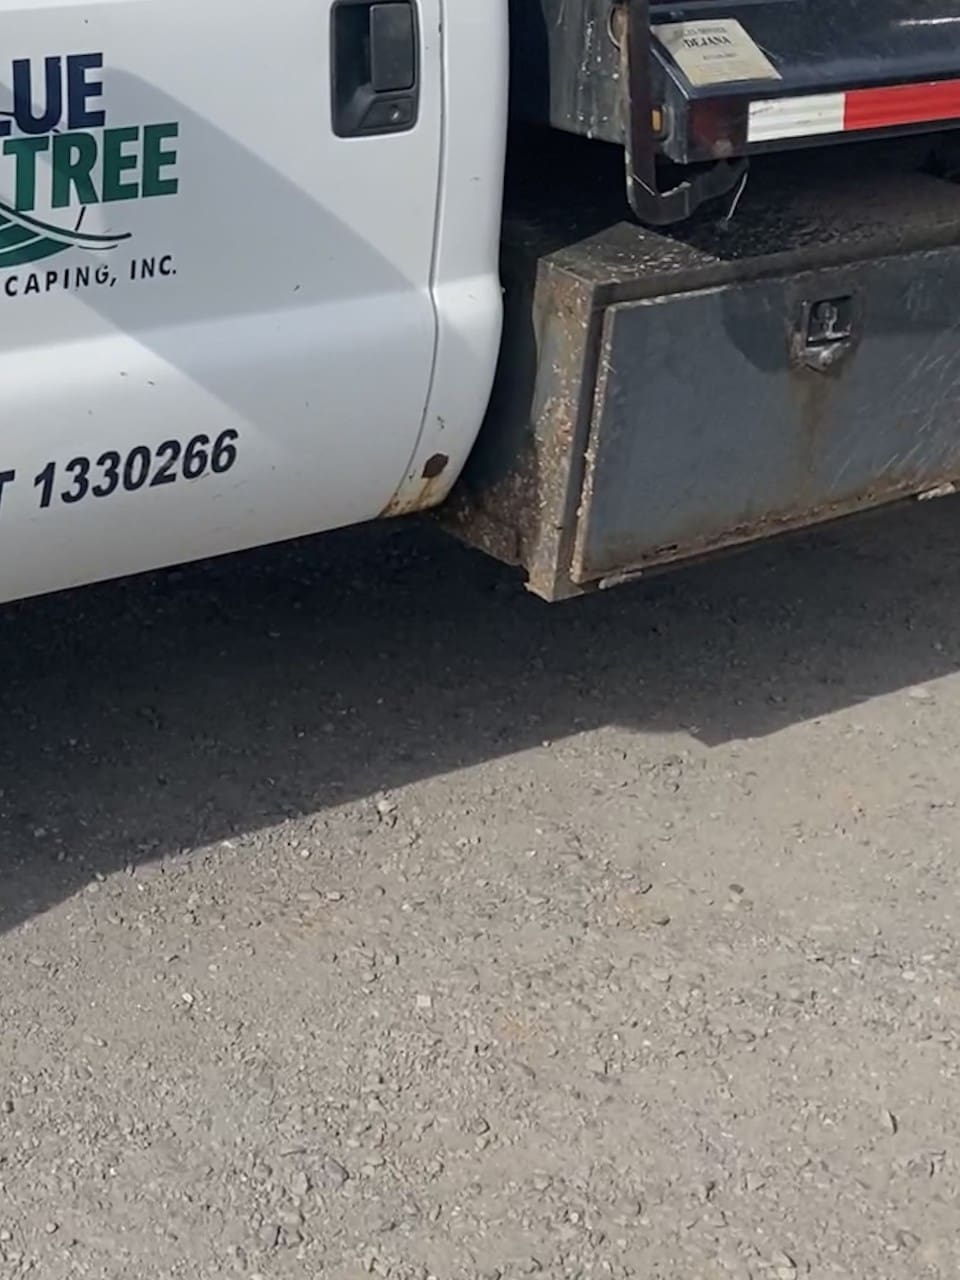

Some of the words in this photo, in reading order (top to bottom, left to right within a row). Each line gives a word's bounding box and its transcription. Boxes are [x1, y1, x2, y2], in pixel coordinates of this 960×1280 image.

[683, 35, 732, 49] DEJANA
[3, 122, 179, 212] TREE
[130, 255, 177, 280] INC.
[33, 428, 238, 509] 1330266
